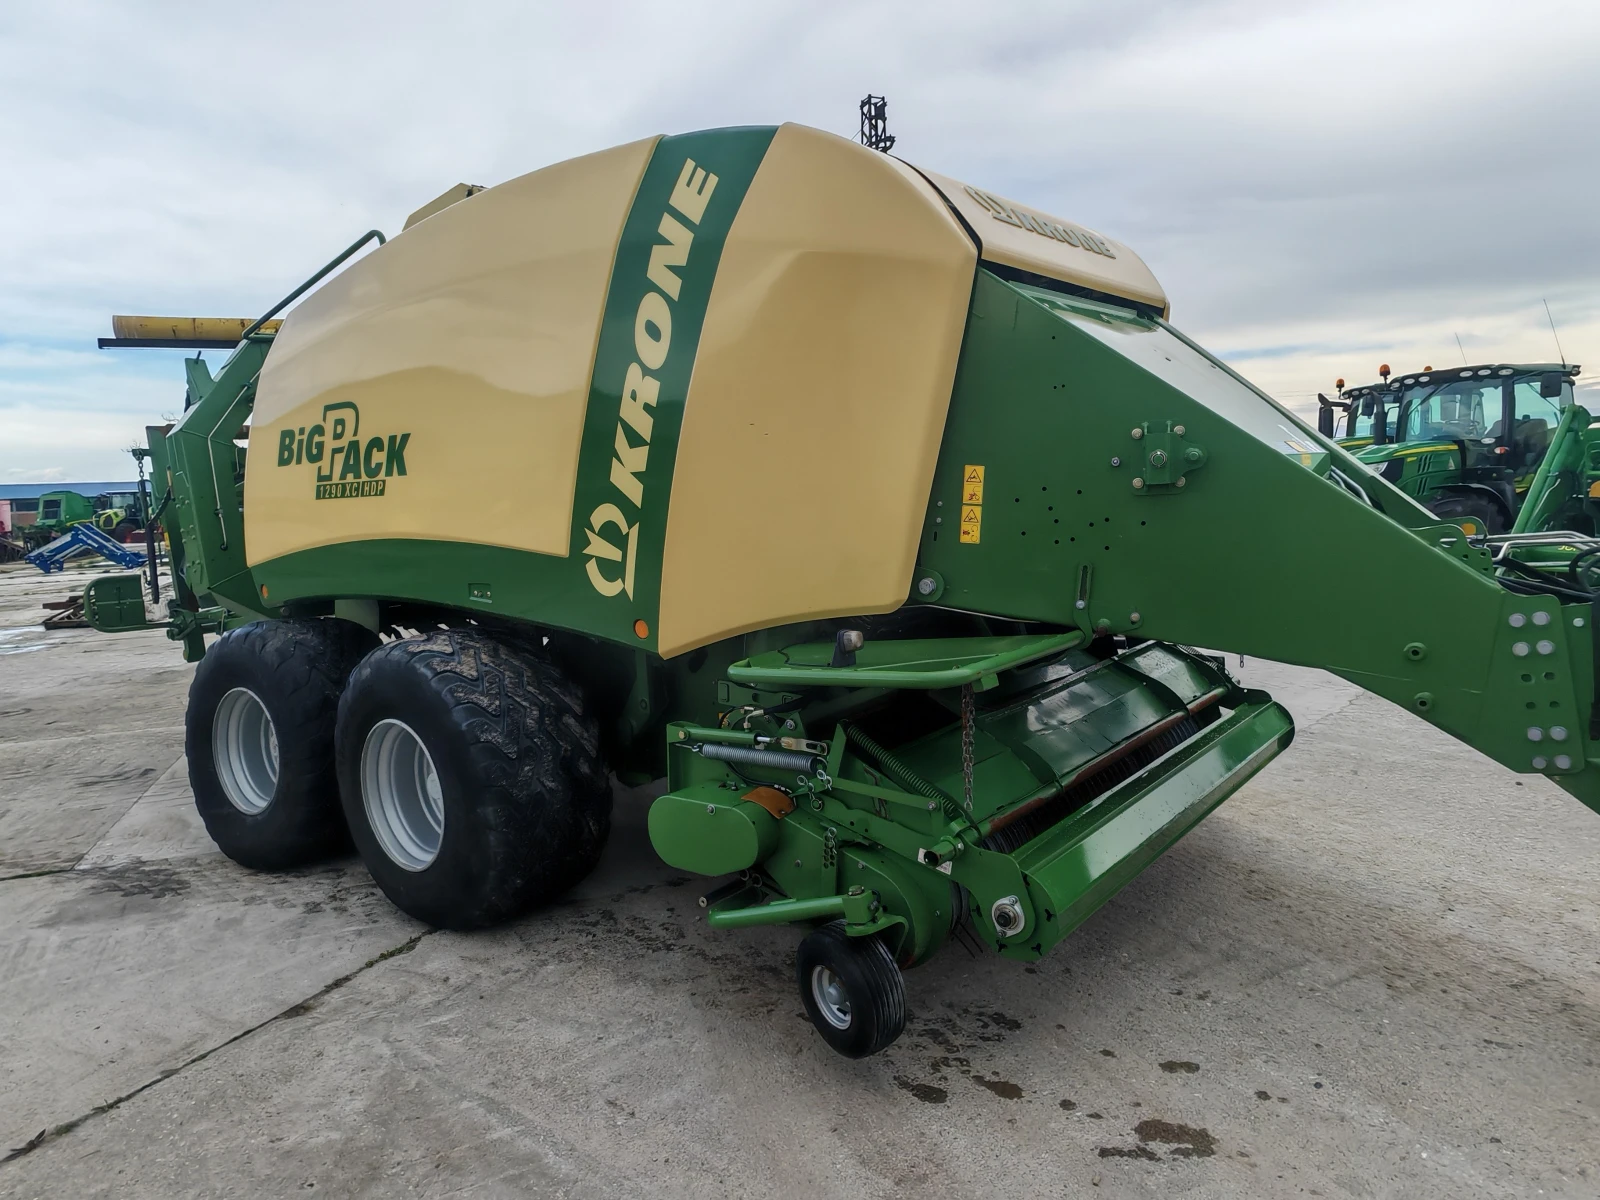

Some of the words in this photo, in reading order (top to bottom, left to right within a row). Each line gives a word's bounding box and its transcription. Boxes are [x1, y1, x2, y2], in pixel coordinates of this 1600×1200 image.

[1009, 208, 1117, 260] KRONE
[609, 157, 719, 510] KRONE
[319, 484, 342, 499] 1290
[344, 483, 358, 498] XC
[363, 481, 384, 497] HDP
